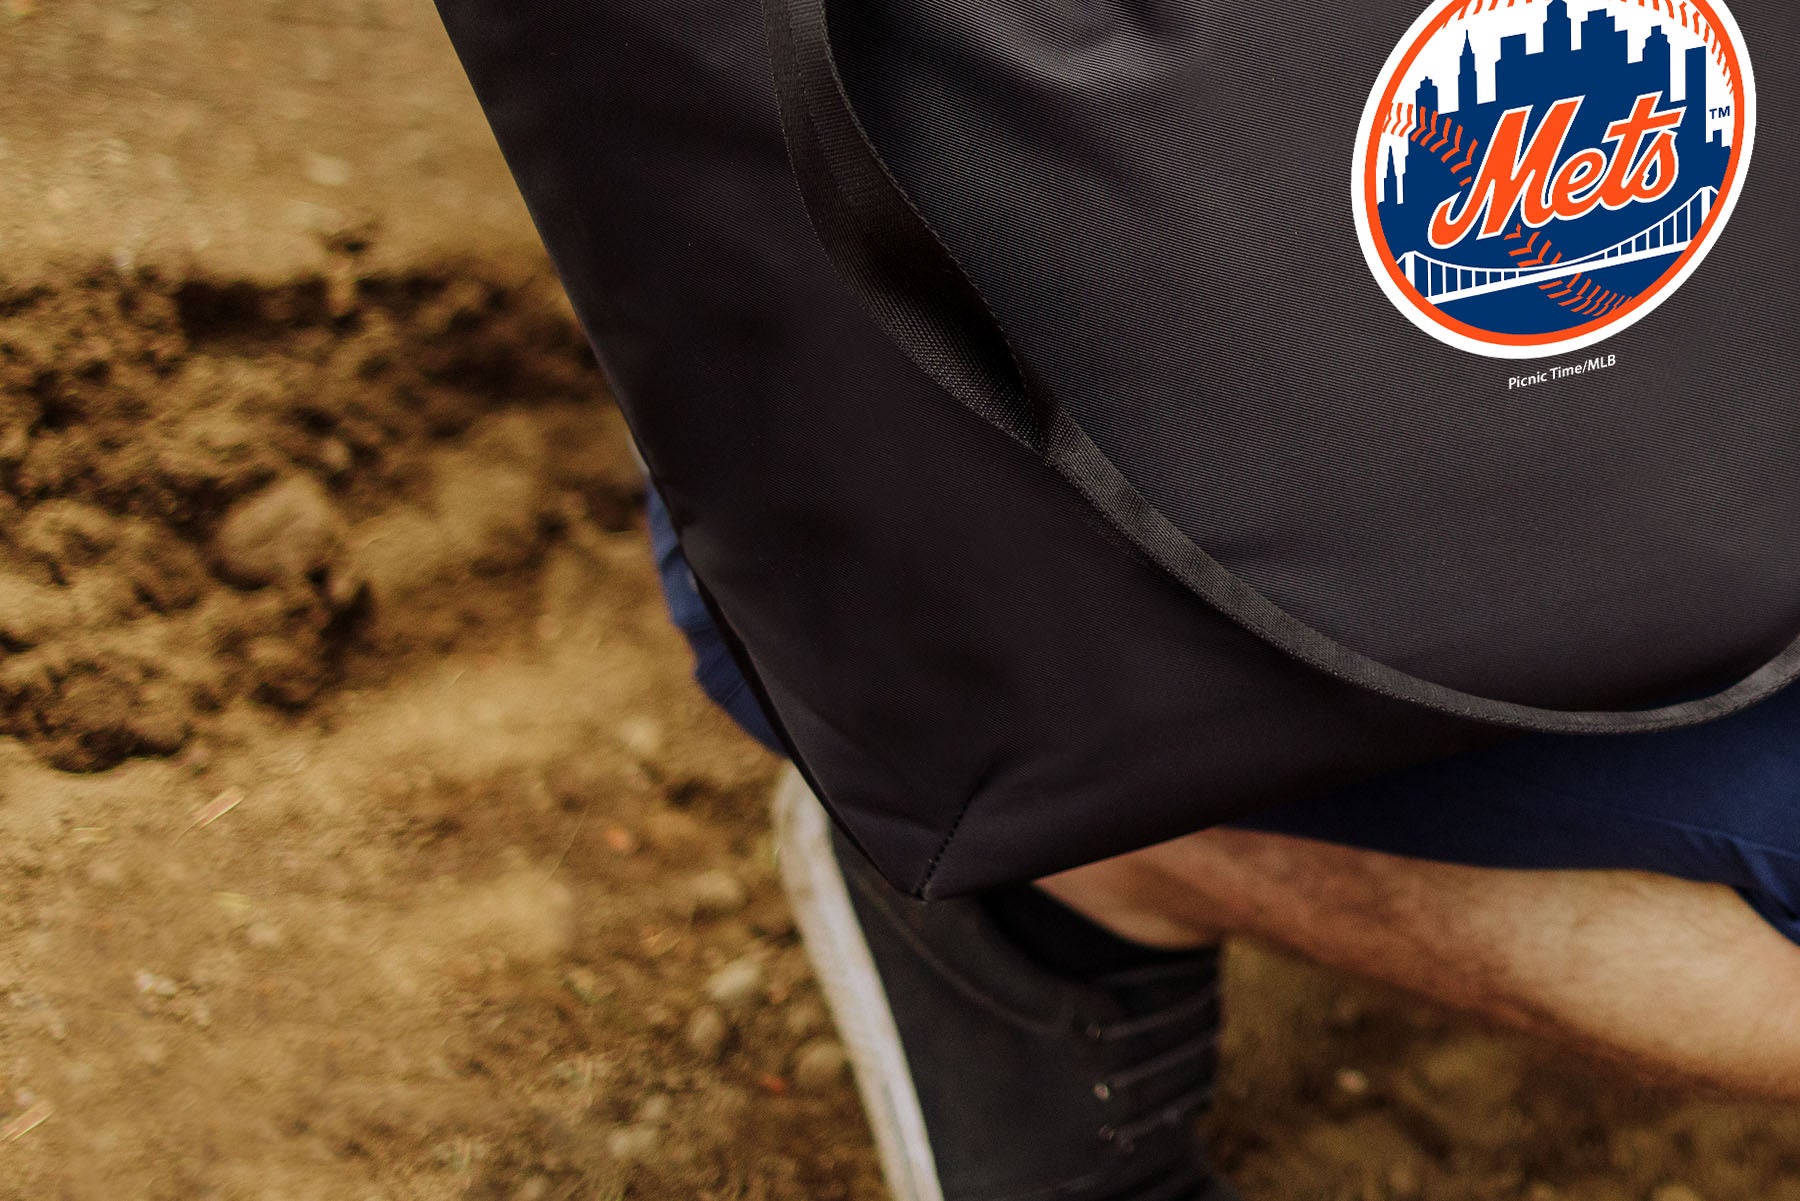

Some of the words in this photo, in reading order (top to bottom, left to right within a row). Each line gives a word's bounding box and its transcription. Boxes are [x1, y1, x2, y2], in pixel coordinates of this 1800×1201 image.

[1427, 91, 1688, 250] Mets
[1508, 371, 1548, 390] Picnic
[1549, 354, 1617, 380] Time/MLB
